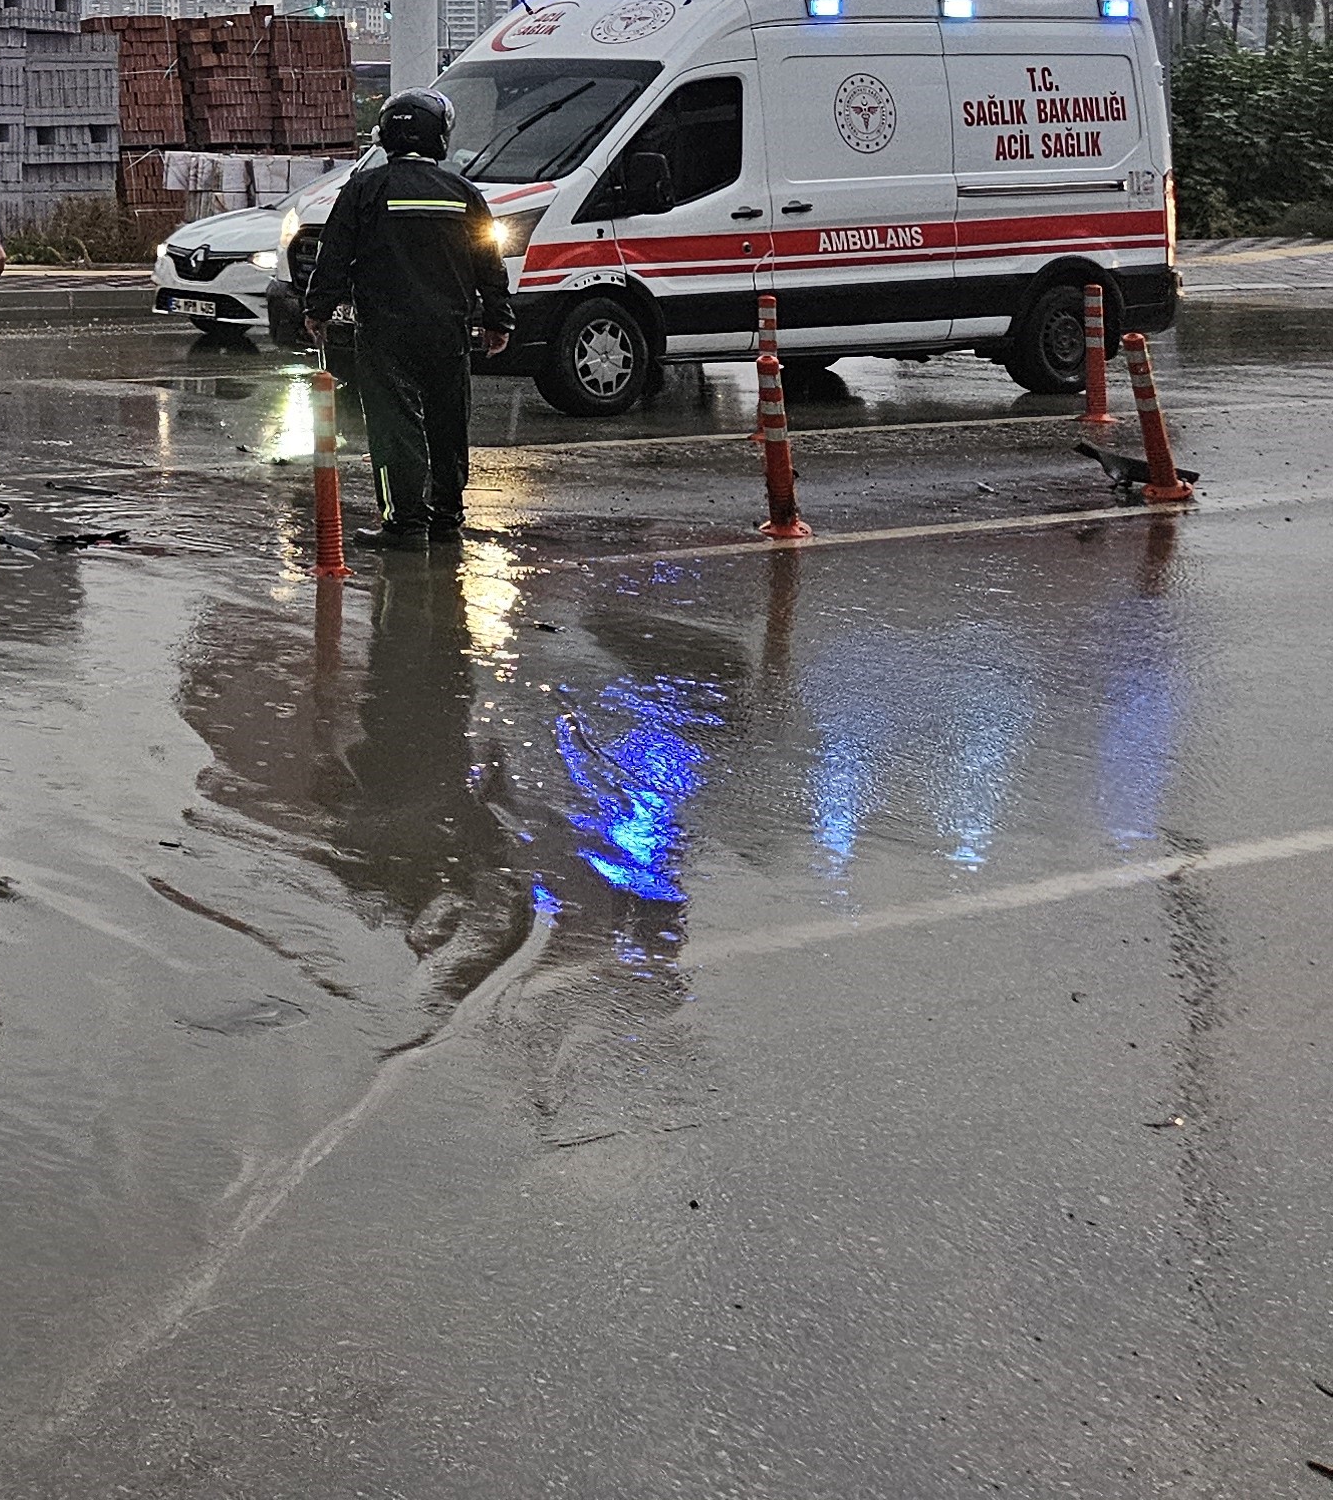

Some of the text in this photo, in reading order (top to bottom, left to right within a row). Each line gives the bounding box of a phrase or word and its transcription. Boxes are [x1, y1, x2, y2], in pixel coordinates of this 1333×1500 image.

[1026, 66, 1059, 92] T.C.
[963, 90, 1127, 126] SAĞLIK BAKANLIĞI
[995, 126, 1102, 161] ACİL SAĞLIK
[818, 226, 924, 253] AMBULANS
